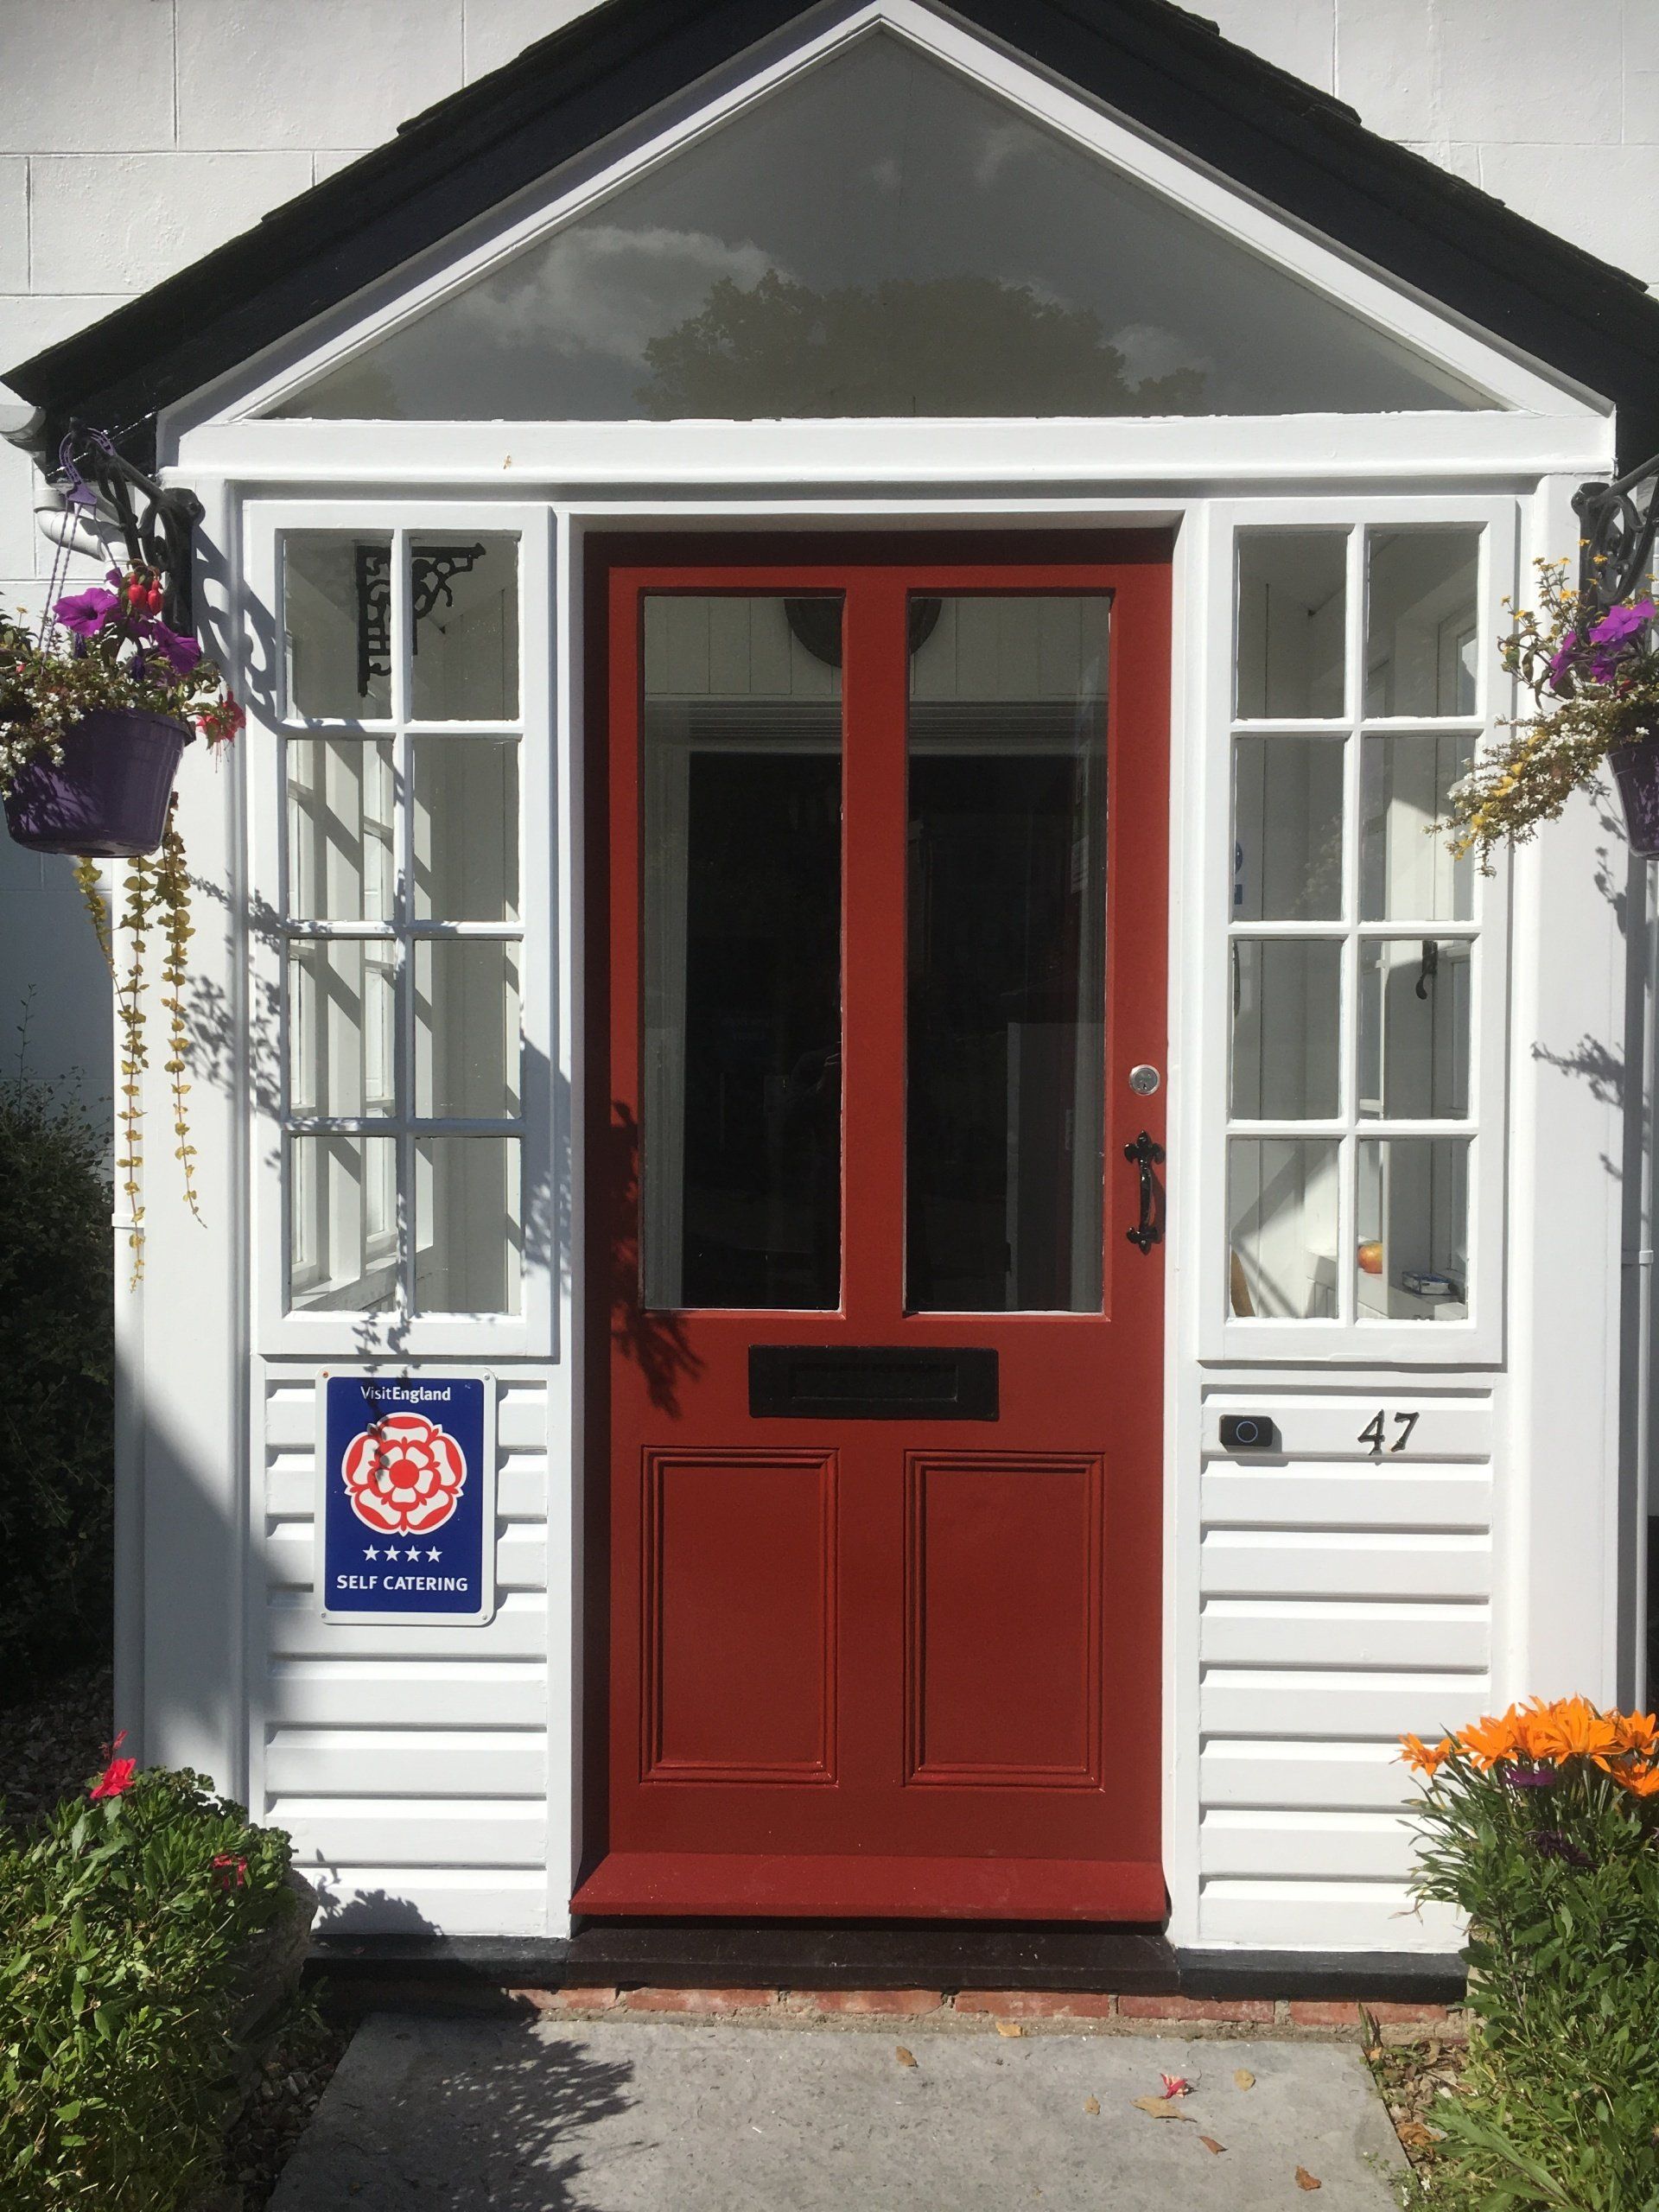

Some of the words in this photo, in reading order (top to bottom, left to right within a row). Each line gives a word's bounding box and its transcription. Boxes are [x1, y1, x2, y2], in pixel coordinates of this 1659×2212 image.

[360, 1386, 451, 1403] VisitEngland
[1357, 1408, 1420, 1455] 47
[336, 1574, 378, 1589] SELF
[383, 1576, 468, 1592] CATERING
